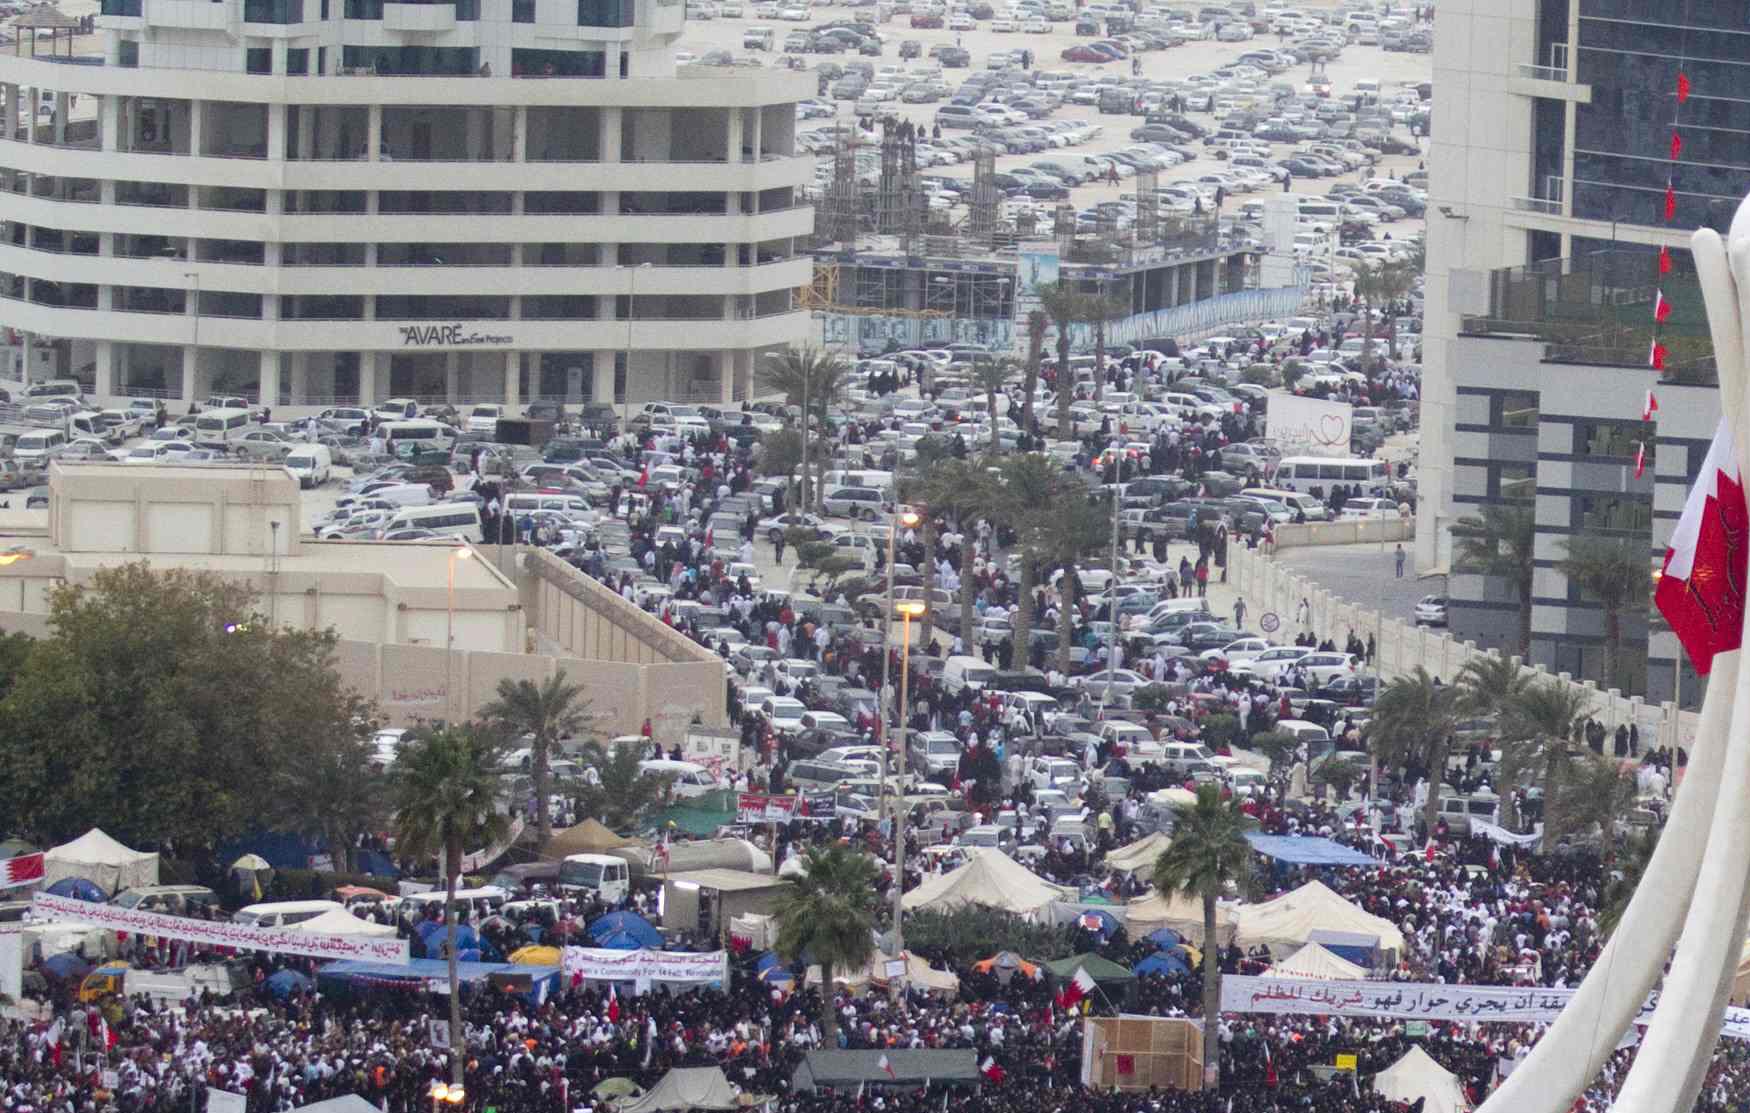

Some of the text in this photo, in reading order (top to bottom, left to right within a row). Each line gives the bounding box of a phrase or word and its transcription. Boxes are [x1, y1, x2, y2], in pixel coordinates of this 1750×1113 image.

[1250, 983, 1303, 1009] للظلم
[1311, 988, 1364, 1009] شريك
[1369, 988, 1402, 1011] فهو
[1406, 991, 1449, 1014] حوار
[1455, 996, 1508, 1015] يجري
